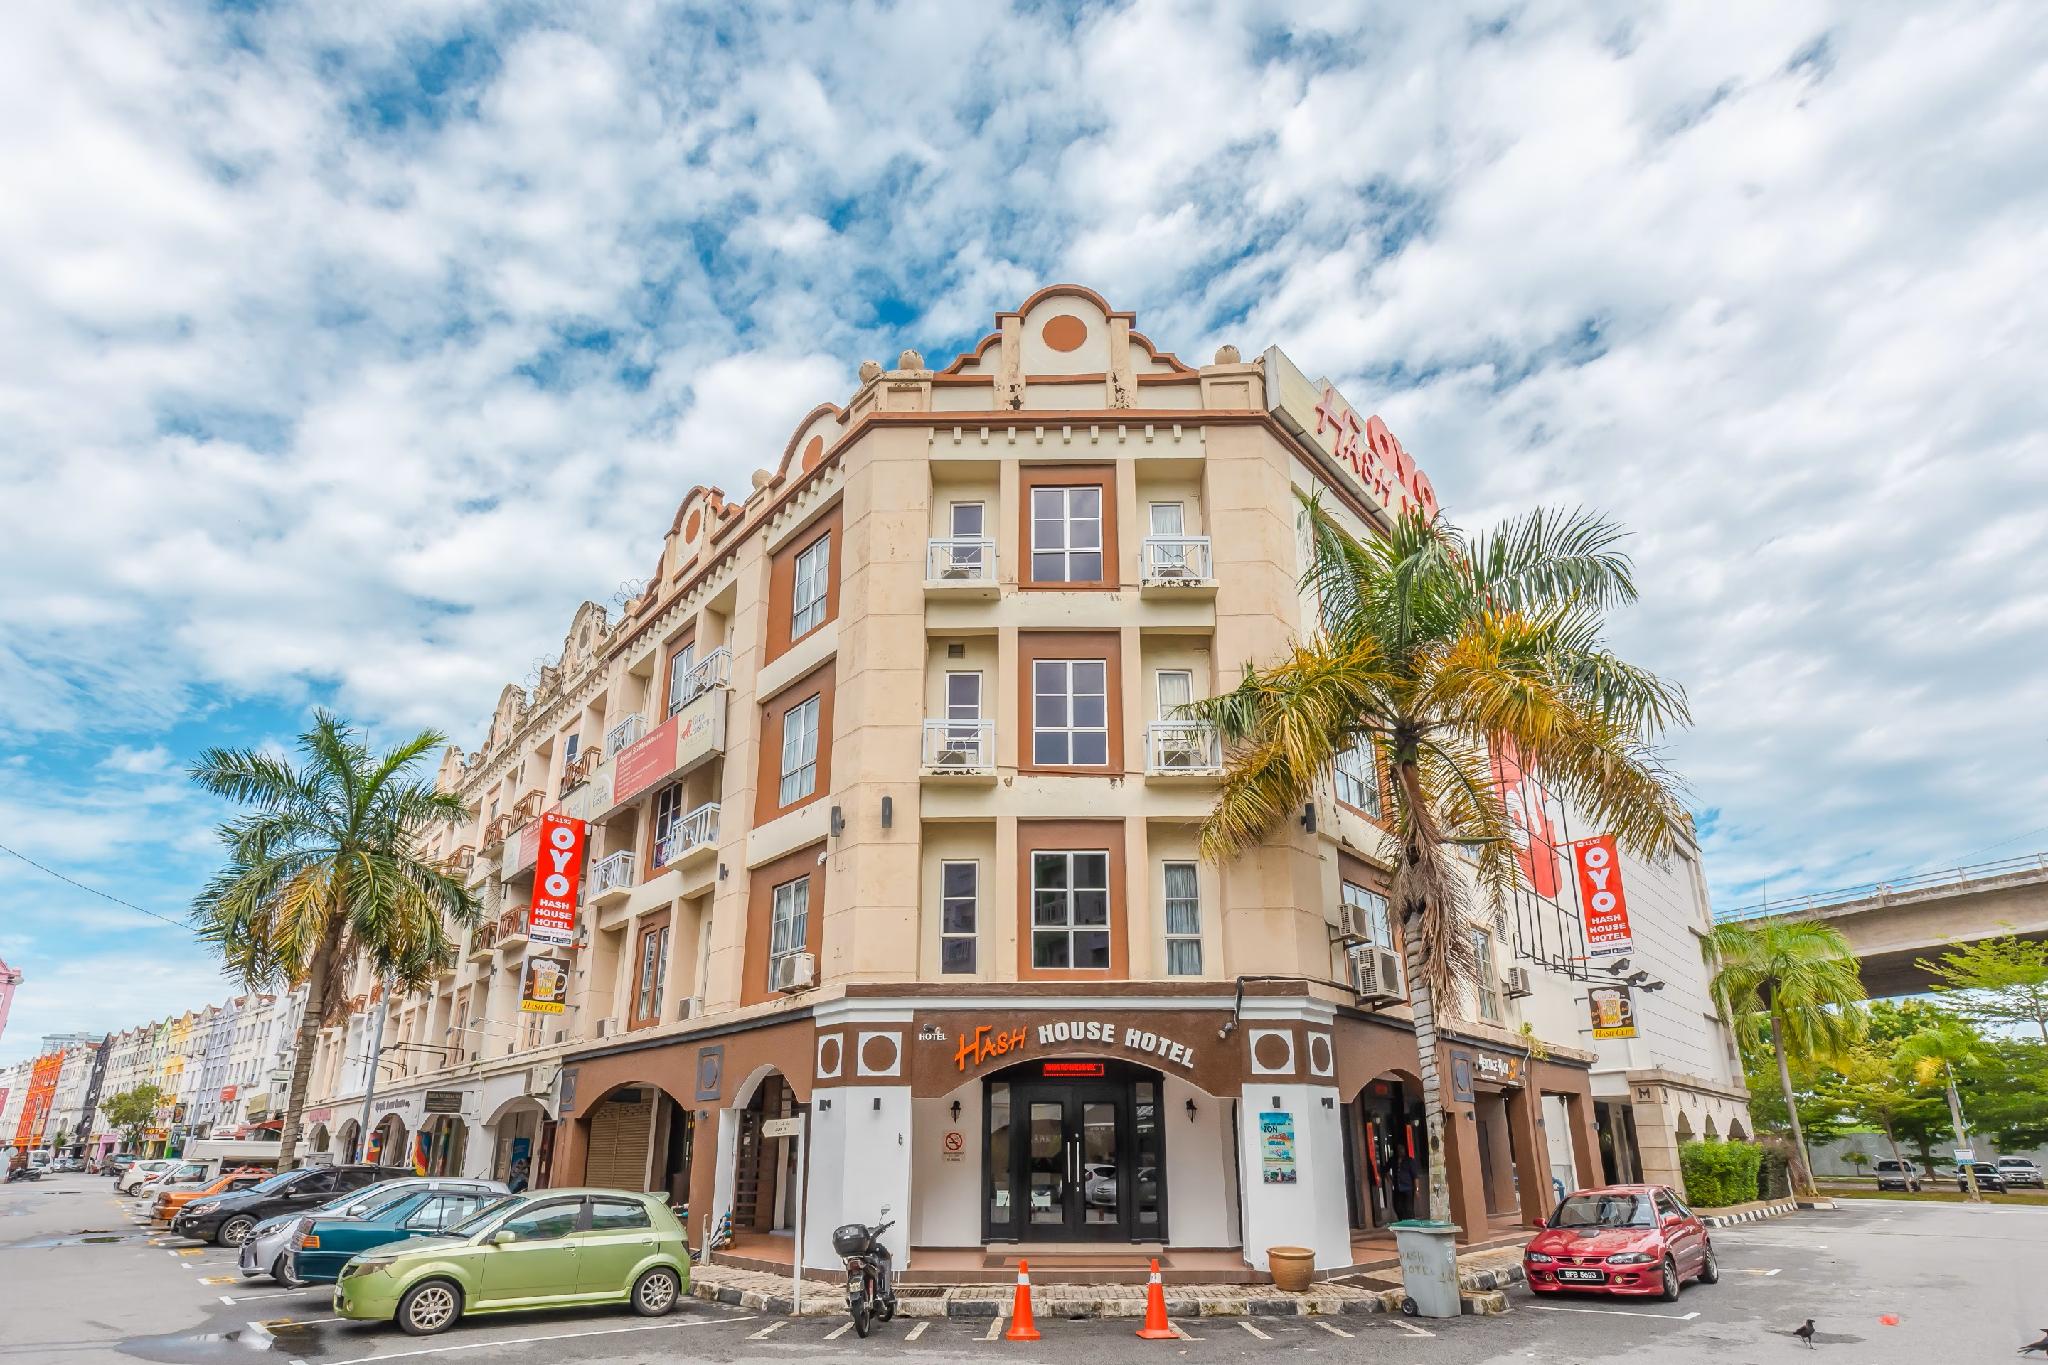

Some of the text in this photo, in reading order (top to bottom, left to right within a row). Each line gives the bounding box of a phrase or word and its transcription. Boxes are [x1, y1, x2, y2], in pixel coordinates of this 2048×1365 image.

[1366, 414, 1439, 522] OYO
[545, 827, 575, 897] OYO
[1585, 847, 1616, 913] OYO
[540, 898, 570, 910] HASH
[535, 907, 572, 920] HOUSE
[1591, 914, 1622, 925] HASH
[535, 917, 570, 929] HOTEL
[1590, 923, 1626, 934] HOUSE
[1591, 933, 1627, 942] HOTEL
[919, 1032, 948, 1041] HOTEL
[1038, 1021, 1115, 1045] HOUSE
[1125, 1028, 1194, 1069] HOTEL
